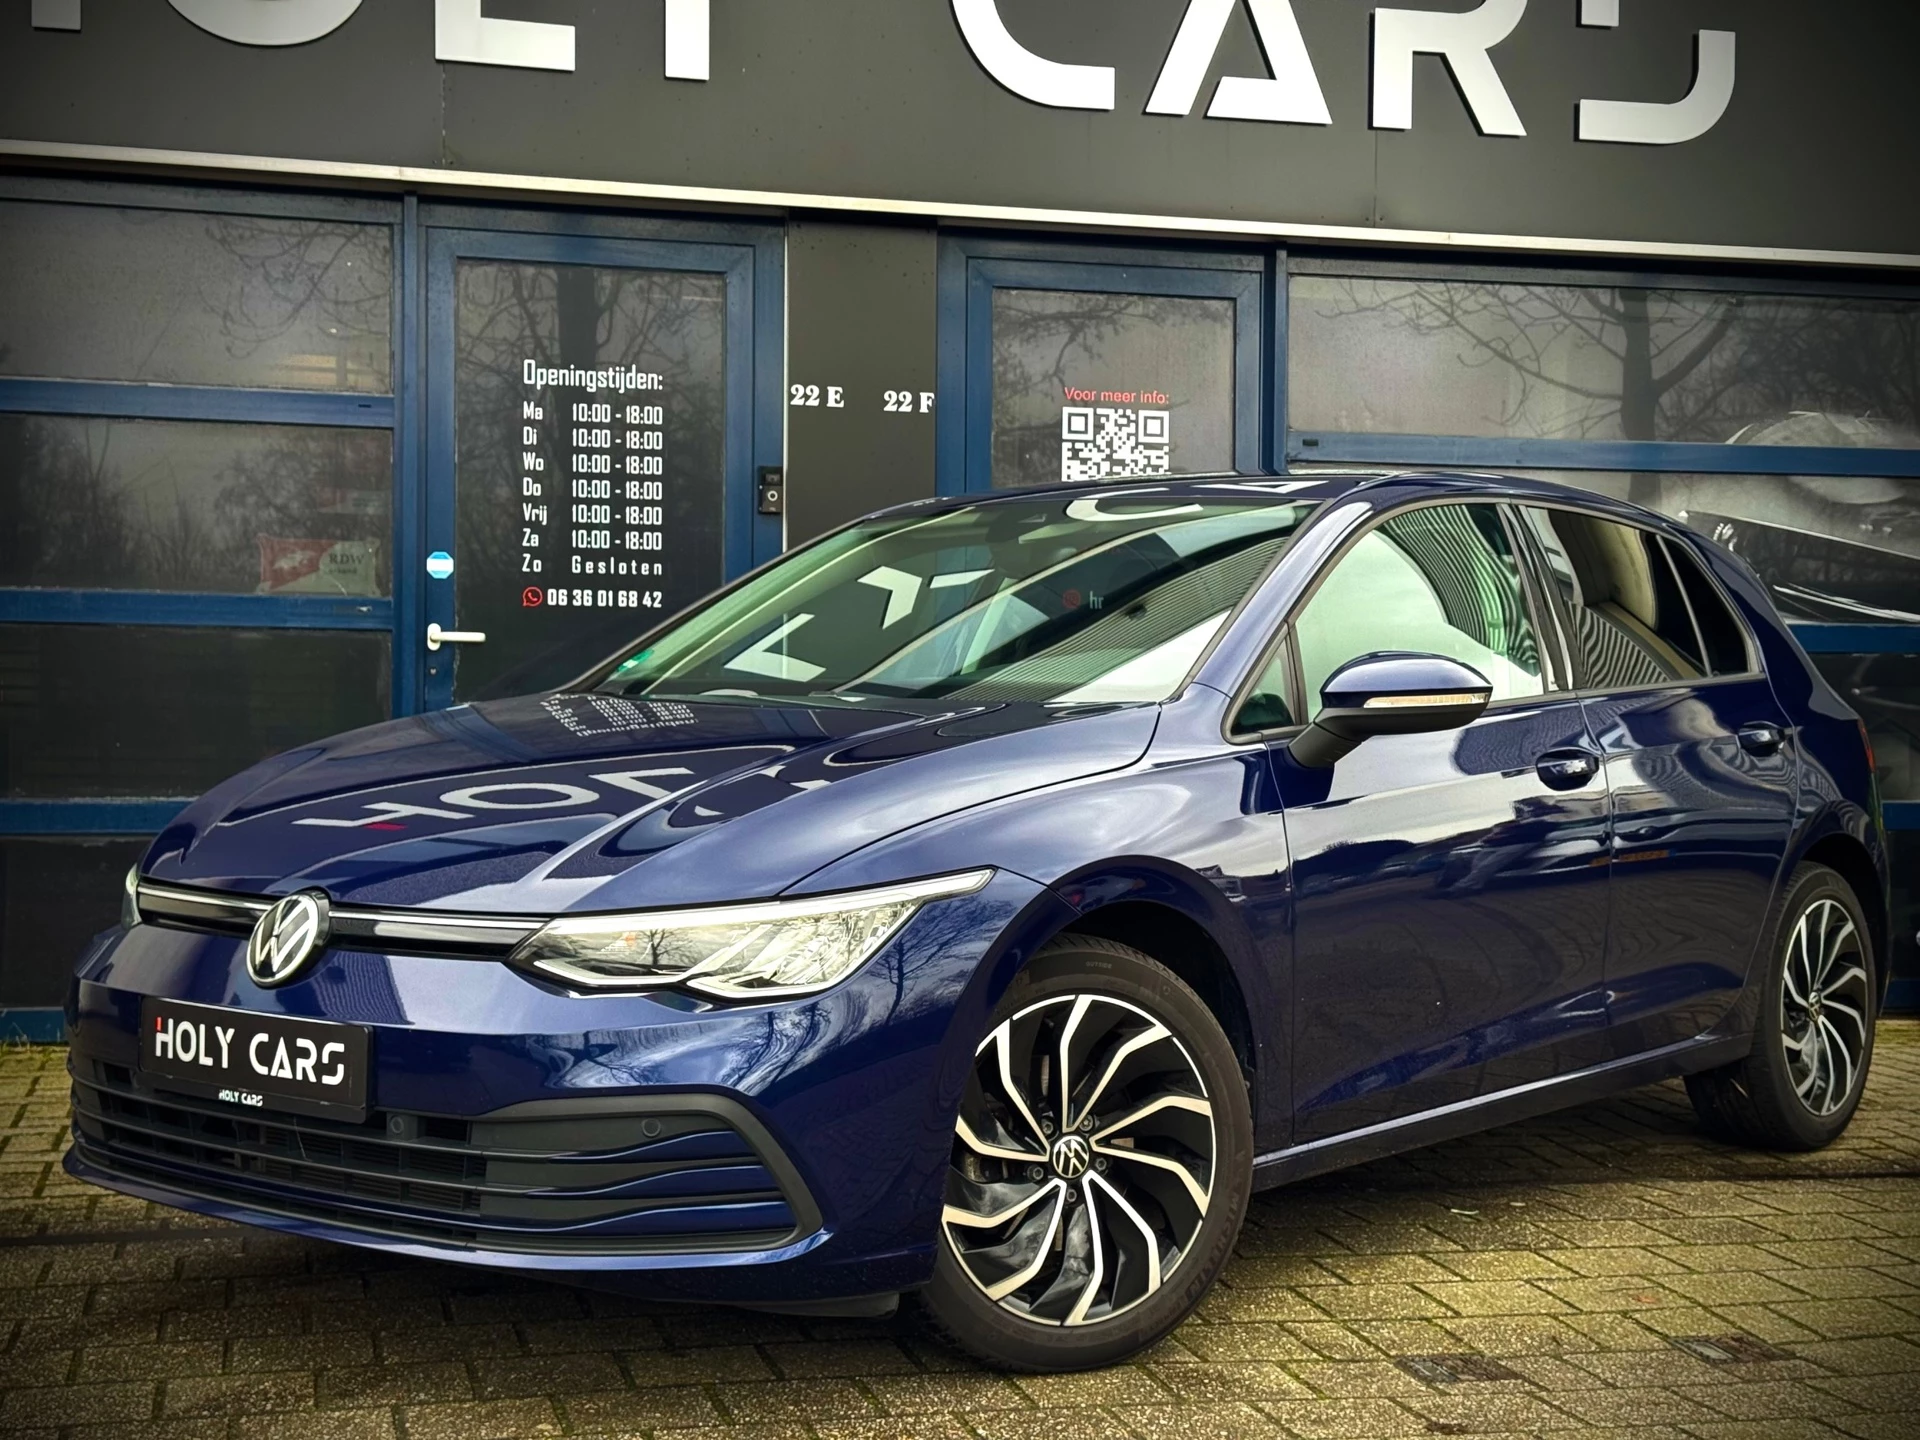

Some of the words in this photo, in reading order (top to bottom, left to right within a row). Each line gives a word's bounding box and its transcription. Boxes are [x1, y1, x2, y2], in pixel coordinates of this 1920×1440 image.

[523, 358, 664, 394] Openingstijden:
[789, 383, 821, 407] 22
[826, 385, 845, 408] E
[883, 390, 913, 413] 22
[919, 391, 936, 414] F
[1064, 387, 1097, 401] Voor
[1100, 390, 1137, 403] meer
[1140, 390, 1170, 404] info:
[523, 400, 544, 421] Ma
[572, 402, 611, 424] 10:00
[625, 405, 663, 426] 18:00
[522, 425, 538, 446] Di
[572, 427, 611, 449] 10:00
[625, 430, 663, 451] 18:00
[522, 451, 545, 472] Wo
[572, 453, 611, 474] 10:00
[625, 455, 663, 476] 18:00
[522, 476, 542, 497] Do
[572, 478, 611, 499] 10:00
[625, 480, 663, 501] 18:00
[522, 502, 548, 526] Vrij
[572, 503, 611, 524] 10:00
[625, 505, 663, 526] 18:00
[521, 527, 540, 548] Za
[572, 528, 611, 549] 10:00
[625, 530, 663, 551] 18:00
[329, 552, 365, 565] RDW
[521, 553, 542, 573] Zo
[571, 555, 663, 576] Gesloten
[547, 588, 568, 606] 06
[572, 589, 593, 607] 36
[597, 589, 614, 607] 01
[617, 590, 638, 608] 68
[642, 590, 663, 608] 42
[155, 1016, 236, 1070] HOLY
[249, 1032, 346, 1086] CARS
[218, 1089, 240, 1103] HOLY
[241, 1092, 263, 1107] CARS
